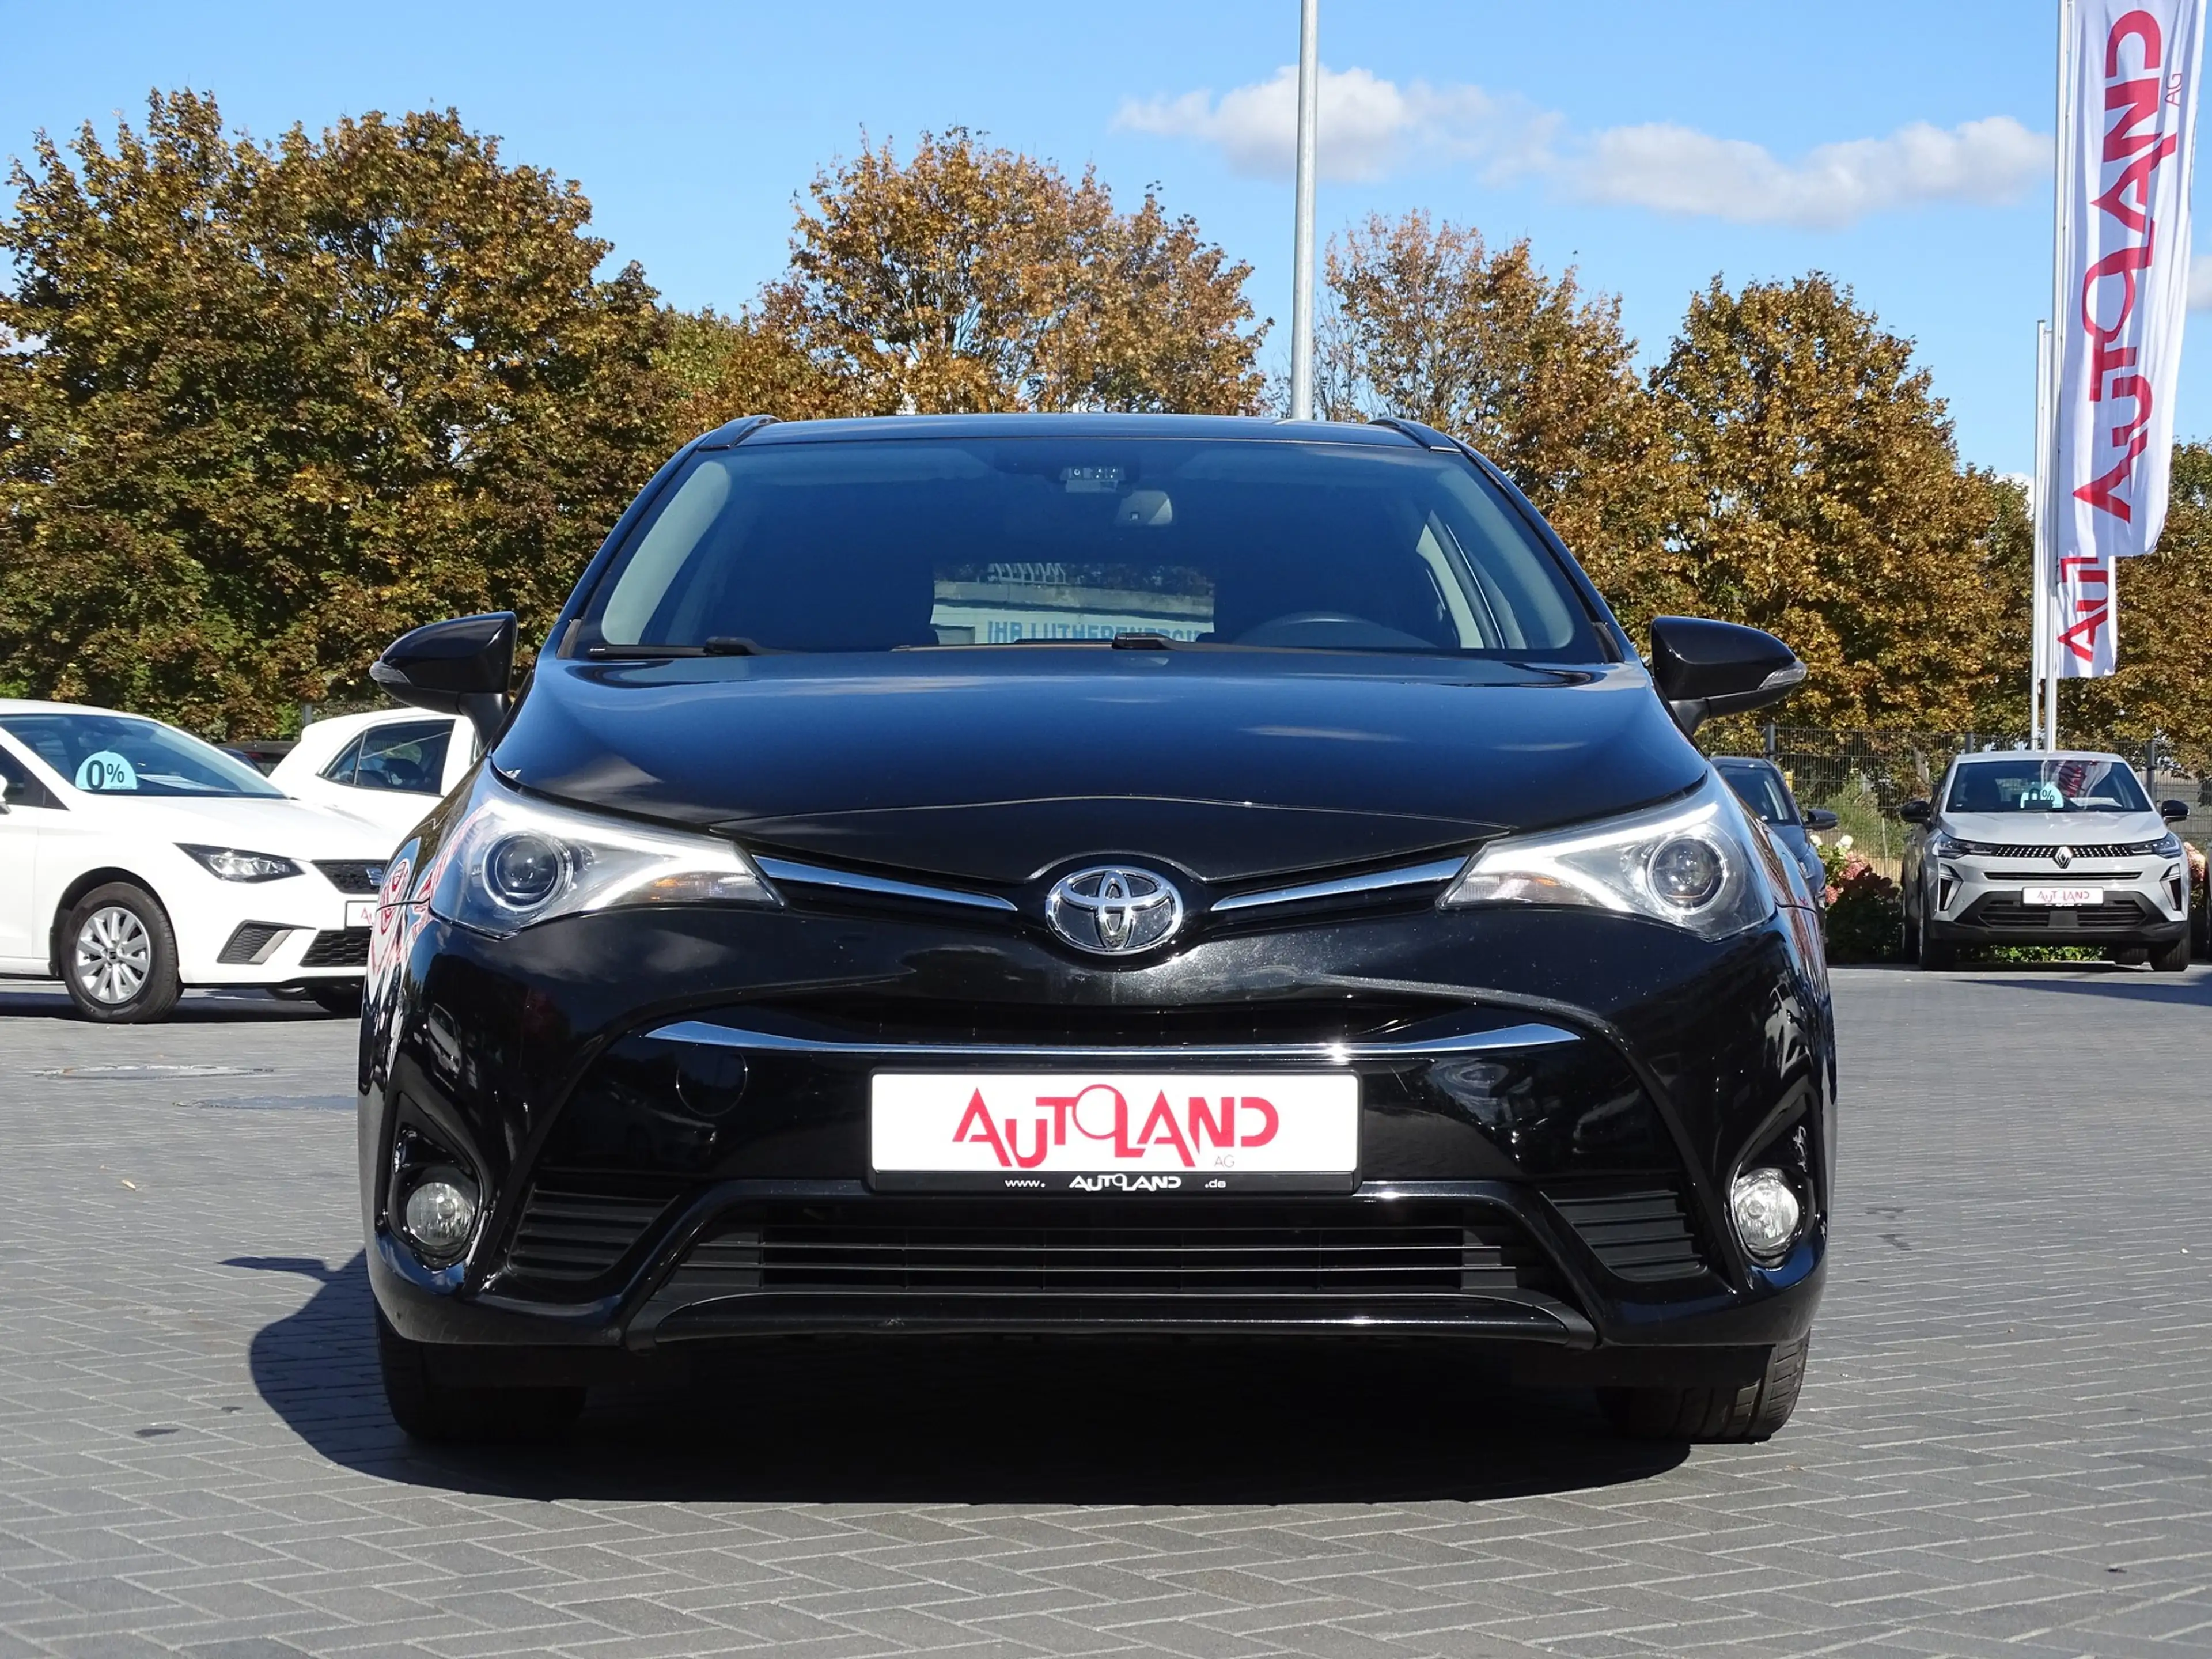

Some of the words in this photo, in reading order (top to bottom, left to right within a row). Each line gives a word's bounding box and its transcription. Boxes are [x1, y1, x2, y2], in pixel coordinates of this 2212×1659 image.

[2165, 73, 2182, 107] AG
[2073, 10, 2177, 522] AUTOLAND
[988, 620, 1023, 643] IHR
[86, 759, 125, 789] 0%
[2037, 891, 2090, 903] AUTLAND
[952, 1084, 1280, 1168] AUTOLAND
[1214, 1154, 1236, 1169] AG
[1004, 1179, 1046, 1188] www.
[1069, 1173, 1181, 1191] AUTOLAND
[1205, 1178, 1226, 1188] .de
